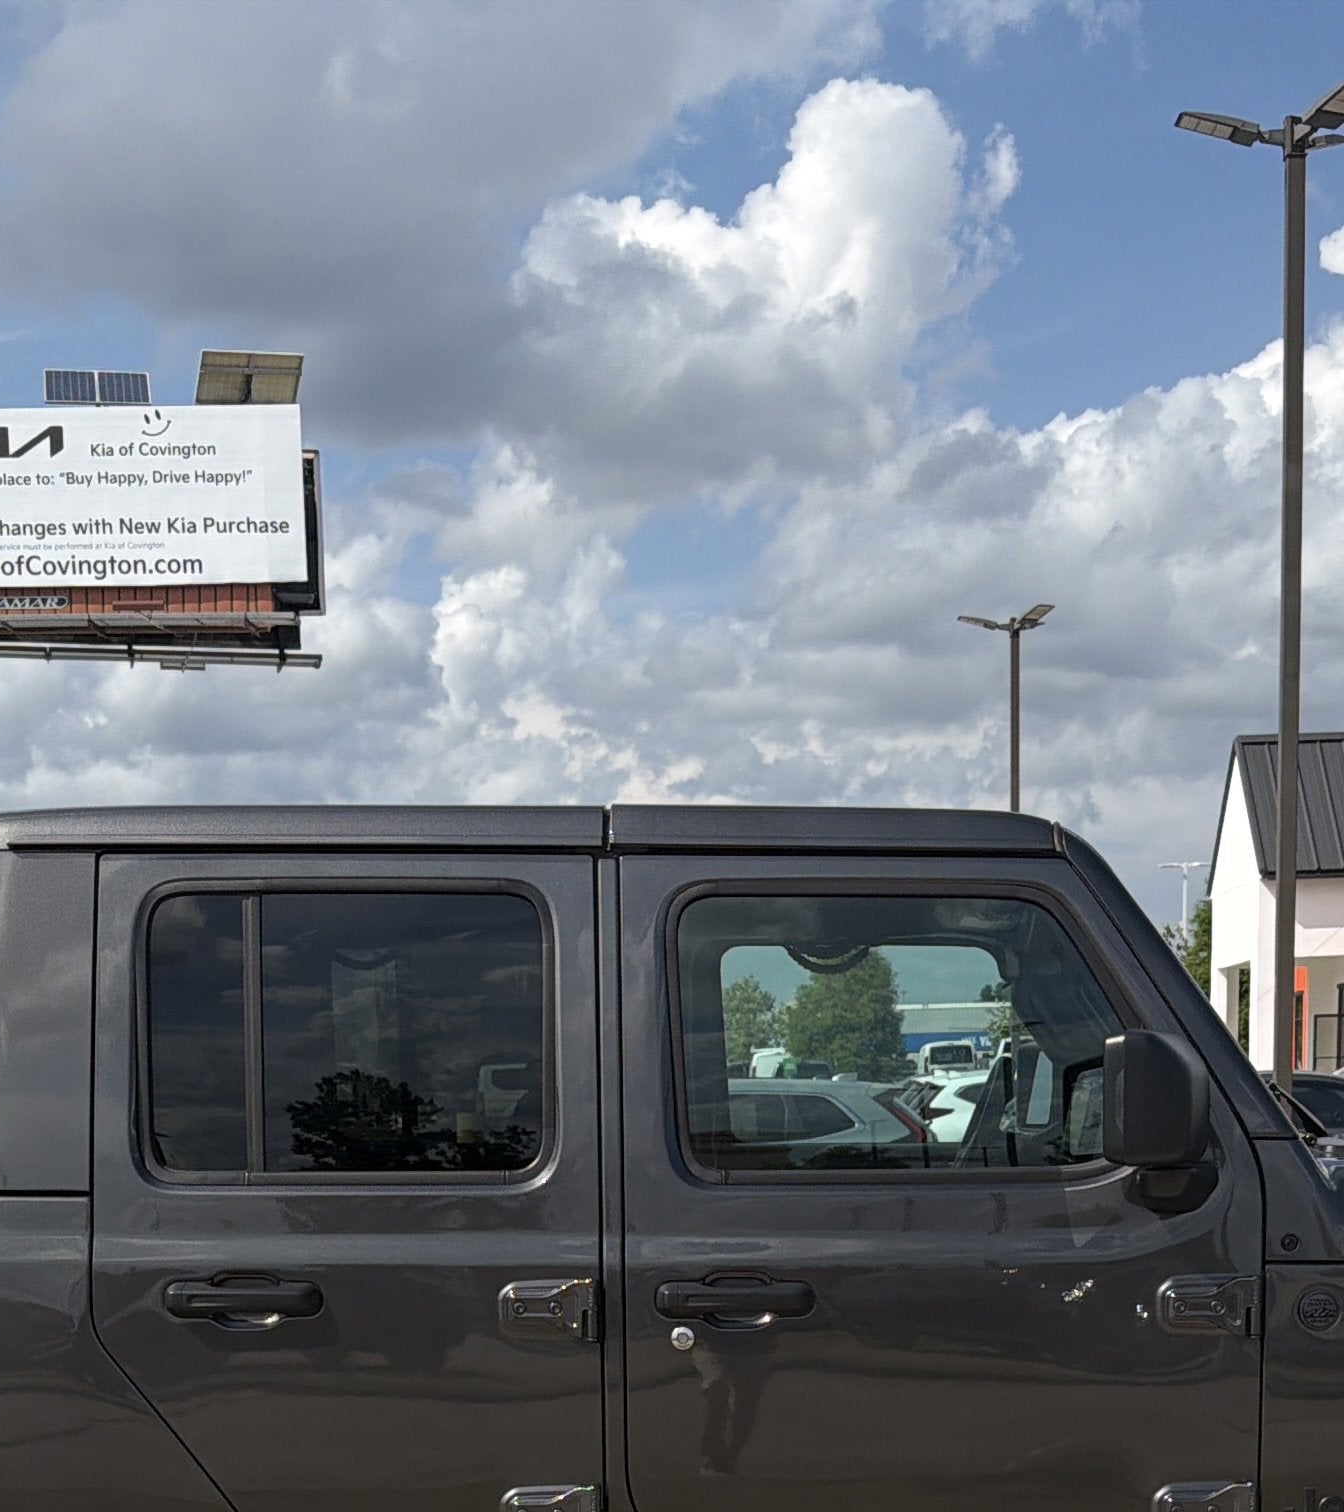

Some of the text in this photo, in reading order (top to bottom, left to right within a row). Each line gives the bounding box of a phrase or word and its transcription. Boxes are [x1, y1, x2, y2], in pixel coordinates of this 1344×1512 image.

[90, 441, 217, 459] Kia of Covington
[35, 472, 56, 486] to:
[97, 471, 148, 487] Happy,
[152, 470, 191, 484] Drive
[72, 517, 114, 535] with
[118, 517, 161, 535] New
[167, 516, 197, 534] Kia
[203, 515, 290, 534] Purchase
[23, 543, 41, 551] must
[43, 543, 52, 551] be
[54, 542, 93, 551] performed
[127, 542, 165, 550] Covington
